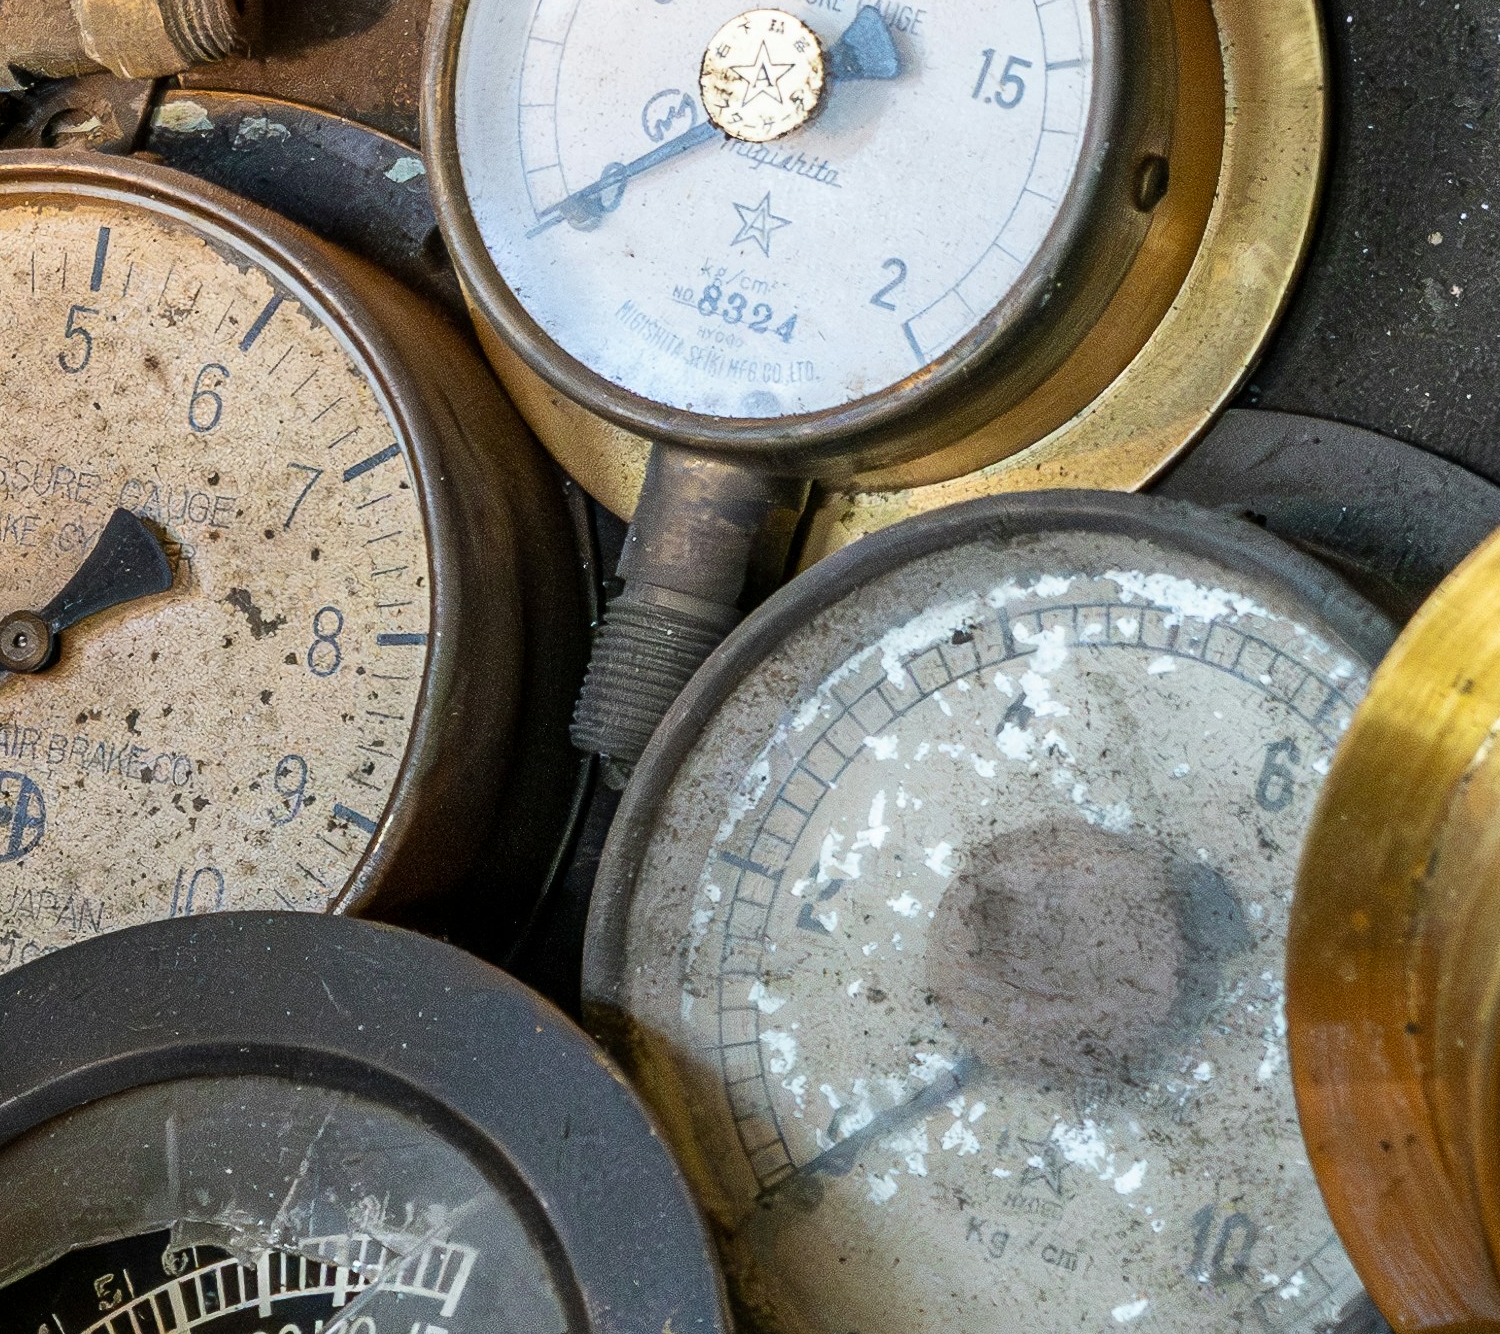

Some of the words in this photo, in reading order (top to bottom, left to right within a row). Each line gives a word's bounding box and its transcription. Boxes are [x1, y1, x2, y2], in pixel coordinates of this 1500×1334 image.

[753, 63, 773, 87] A
[972, 48, 1032, 109] 1.5
[600, 162, 628, 213] 0
[698, 283, 798, 343] 8324
[871, 258, 908, 312] 2
[58, 305, 101, 374] 5
[189, 363, 229, 432] 6
[119, 478, 240, 529] GAUGE
[284, 463, 323, 530] 7
[308, 606, 343, 677] 8
[47, 735, 151, 779] BRAKE
[1256, 736, 1301, 812] 6
[269, 754, 307, 826] 9
[0, 885, 105, 932] JAPAN
